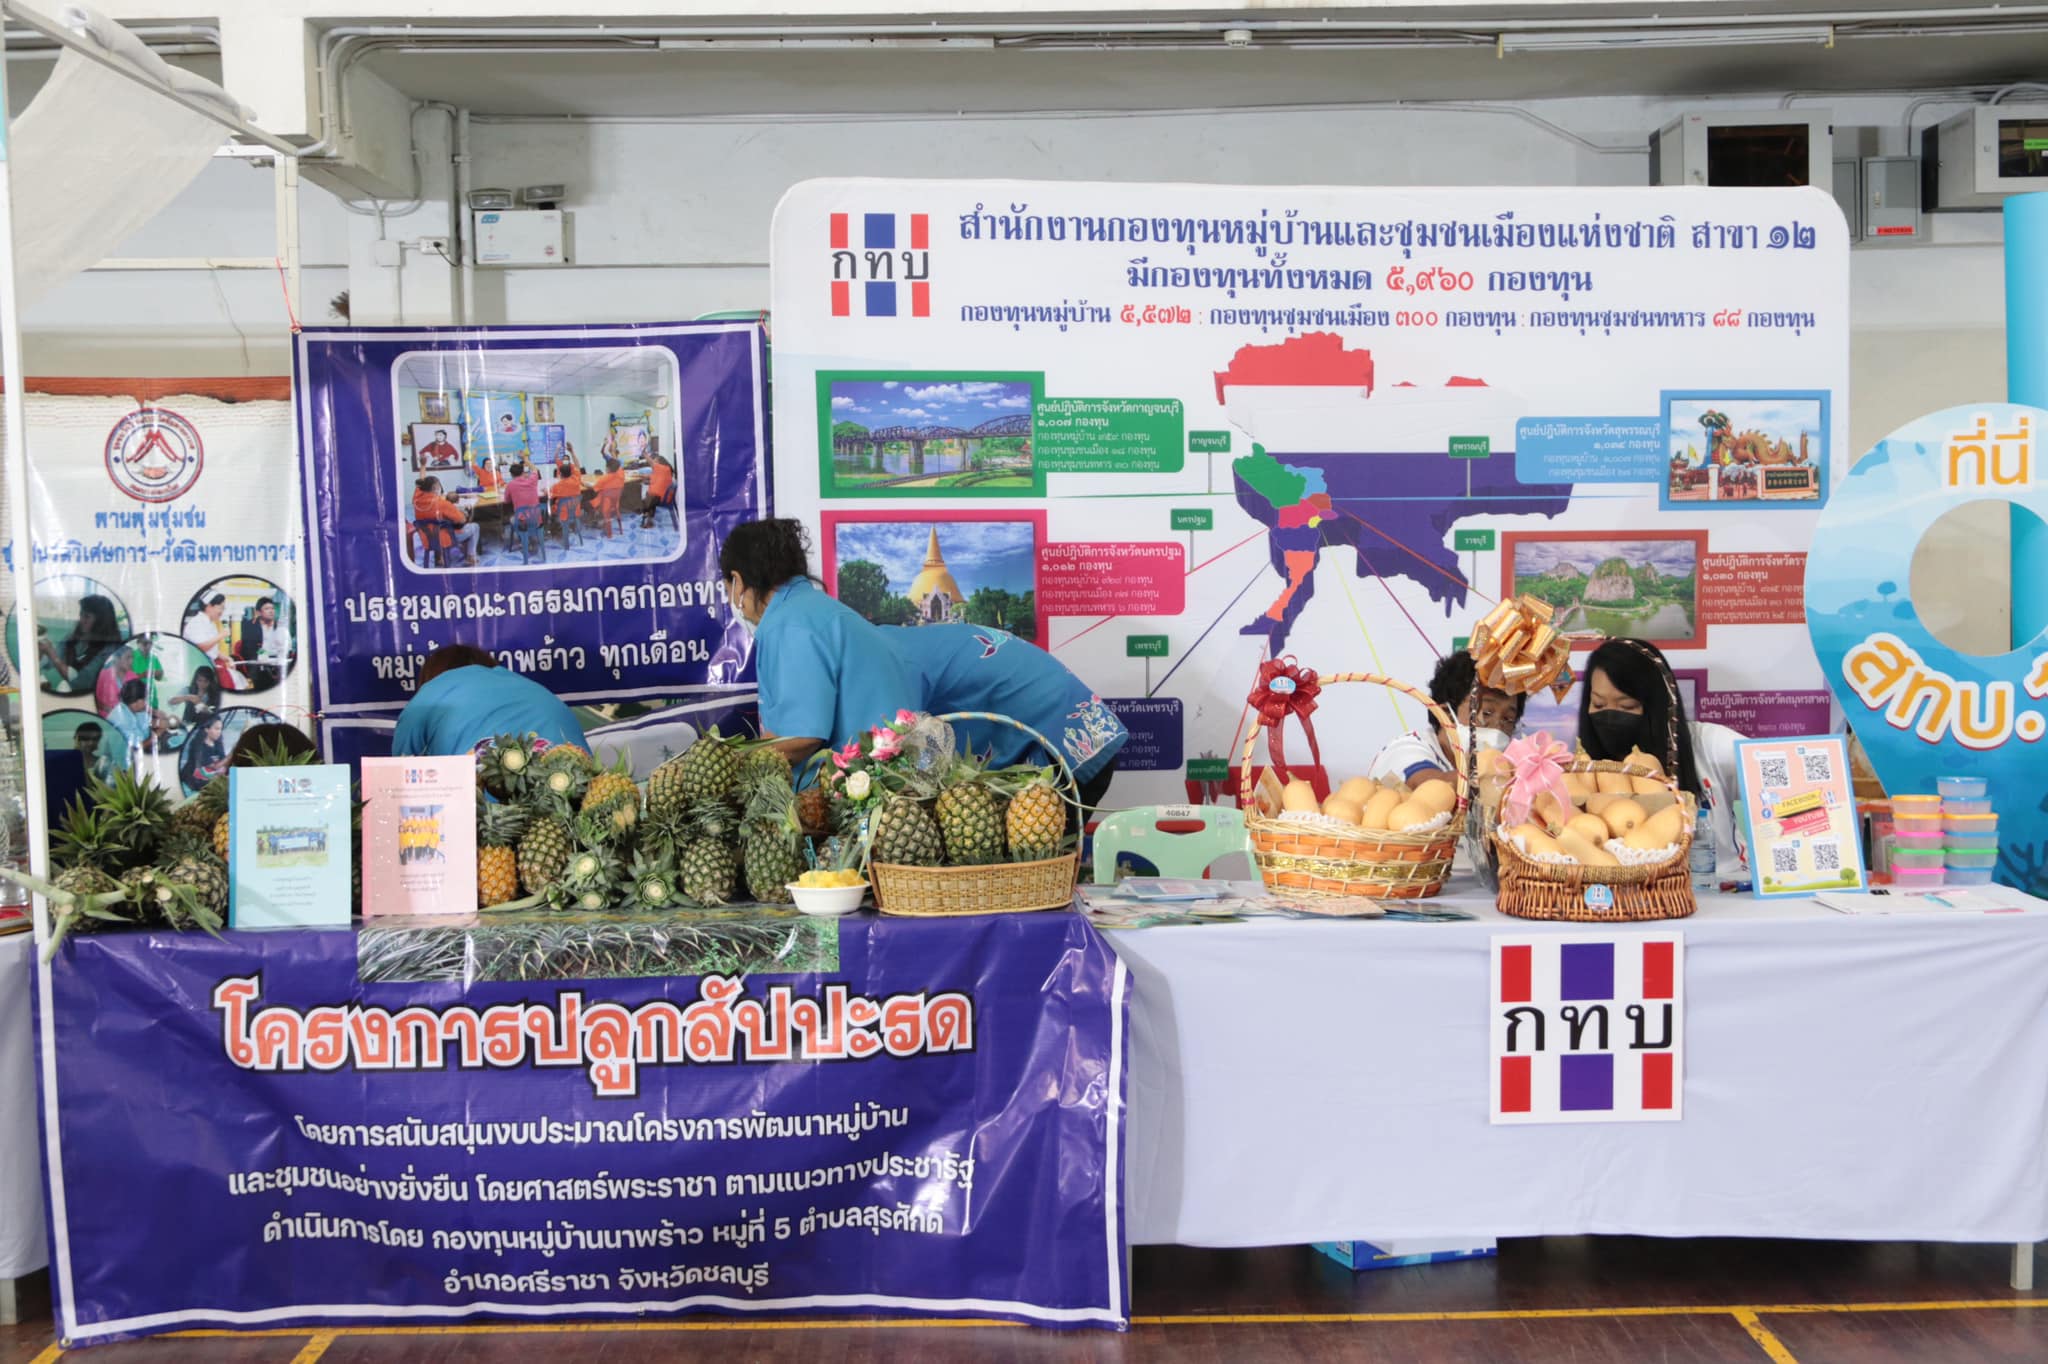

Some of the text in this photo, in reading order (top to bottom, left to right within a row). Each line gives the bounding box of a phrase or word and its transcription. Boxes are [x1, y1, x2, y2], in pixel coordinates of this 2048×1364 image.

[960, 203, 1816, 259] สำนักงานกองทุนหมู่บ้านและชุมชนเมืองแห่งชาติ สาขา ๑๒
[831, 250, 930, 281] กทบ
[1127, 252, 1593, 300] มีกองทุนทั้งหมด ๕,๙๖๐ กองทุน
[960, 300, 1111, 332] กองทุนหมู่บ้าน
[1120, 303, 1191, 327] ๕,๕๗๒
[1209, 304, 1390, 333] กองทุนชุมชนเมือง
[1395, 309, 1438, 328] ๓๐๐
[1445, 310, 1517, 335] กองทุน
[1530, 308, 1706, 336] กองทุนชุมชนทหาร
[1712, 308, 1740, 328] ๘๘
[1747, 311, 1815, 336] กองทุน
[1075, 416, 1109, 430] กองทุน
[1628, 439, 1661, 453] กองทุน
[1947, 416, 2029, 486] ที่นี่
[95, 504, 206, 538] พานพุ่มชุมชน
[1079, 561, 1112, 575] กองทุน
[1737, 571, 1768, 583] กองทุน
[600, 629, 709, 680] ทุกเดือน
[1848, 638, 2048, 742] สทบ.
[215, 976, 974, 1096] โครงการปลูกสัปปะรด
[1503, 1003, 1673, 1052] กทบ
[294, 1102, 909, 1154] โดยการสนับสนุนงบประมาณโครงการพัฒนาหมู่บ้าน
[228, 1151, 974, 1202] และชุมชนอย่างยั่งยืน โดยศาสตร์พระราชา ตามแนวทางประชารัฐ
[263, 1211, 424, 1247] ดำเนินการโดย
[433, 1218, 704, 1257] กองทุนหมู่บ้านนาพร้าว
[713, 1208, 765, 1251] หมู่ที่
[774, 1217, 791, 1240] 5
[444, 1261, 769, 1294] อำเภอศรีราชา จังหวัดชลบุรี
